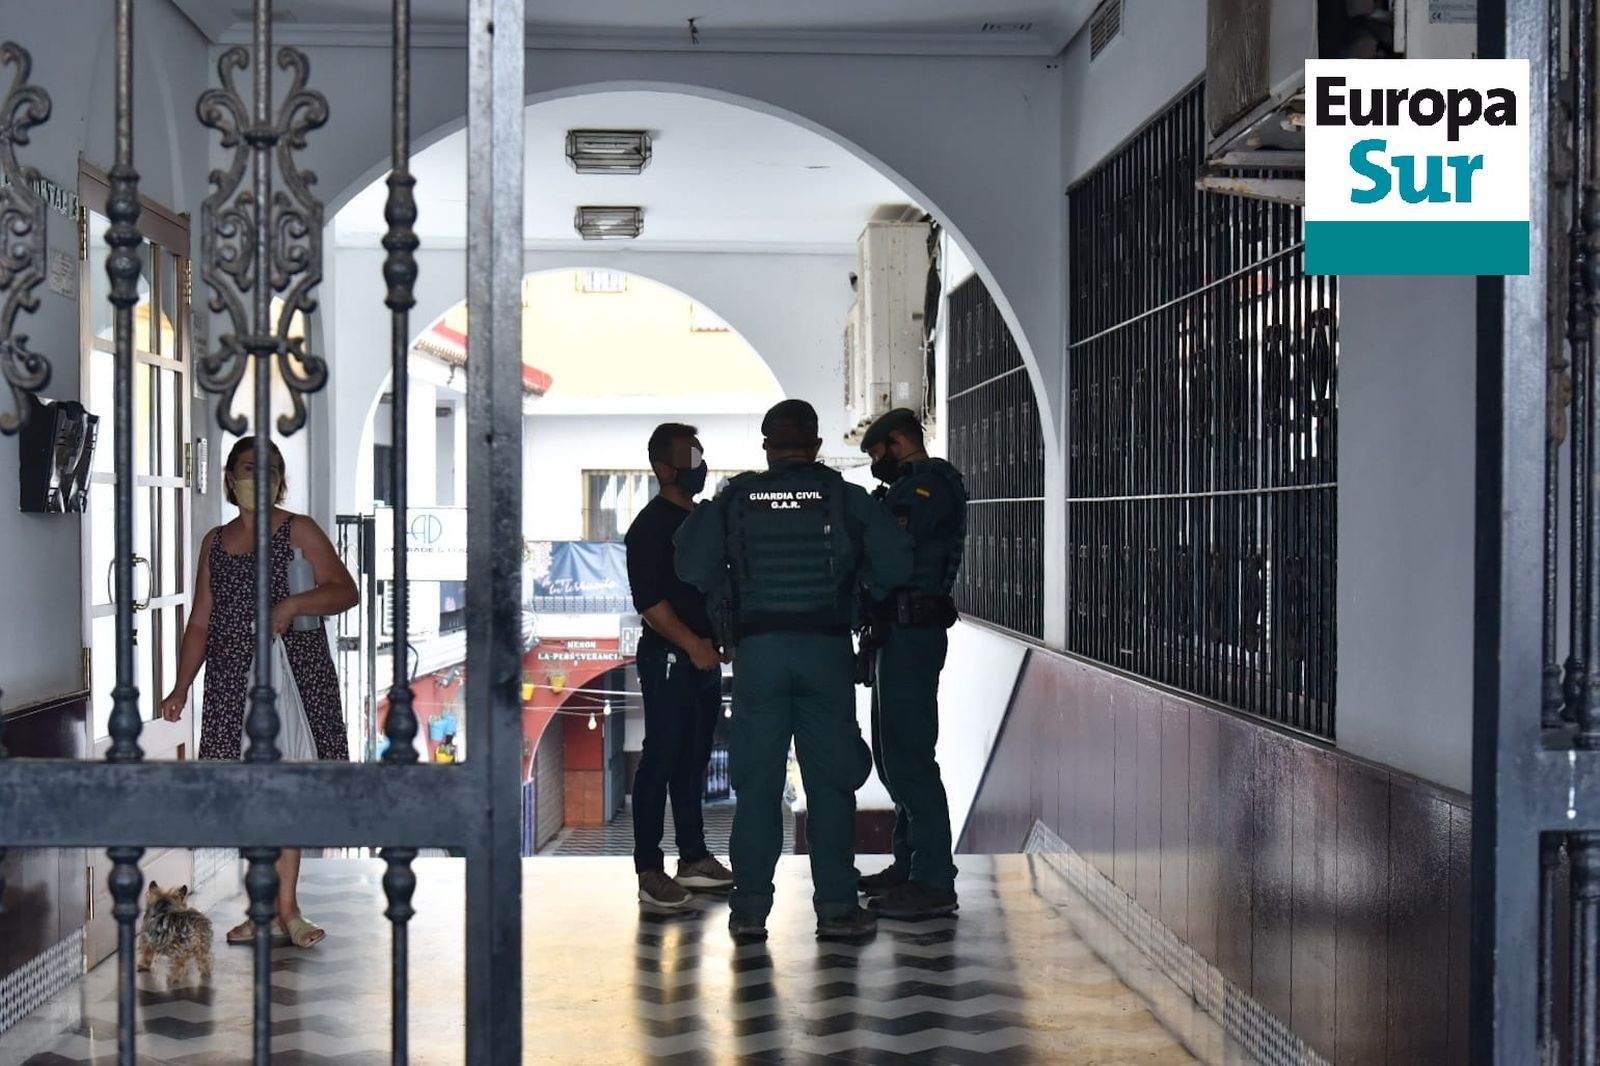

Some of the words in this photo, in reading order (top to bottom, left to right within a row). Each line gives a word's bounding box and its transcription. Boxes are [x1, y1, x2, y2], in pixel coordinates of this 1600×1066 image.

[749, 492, 794, 500] GUARDIA
[796, 491, 823, 499] CIVIL
[771, 501, 801, 509] G.A.R.
